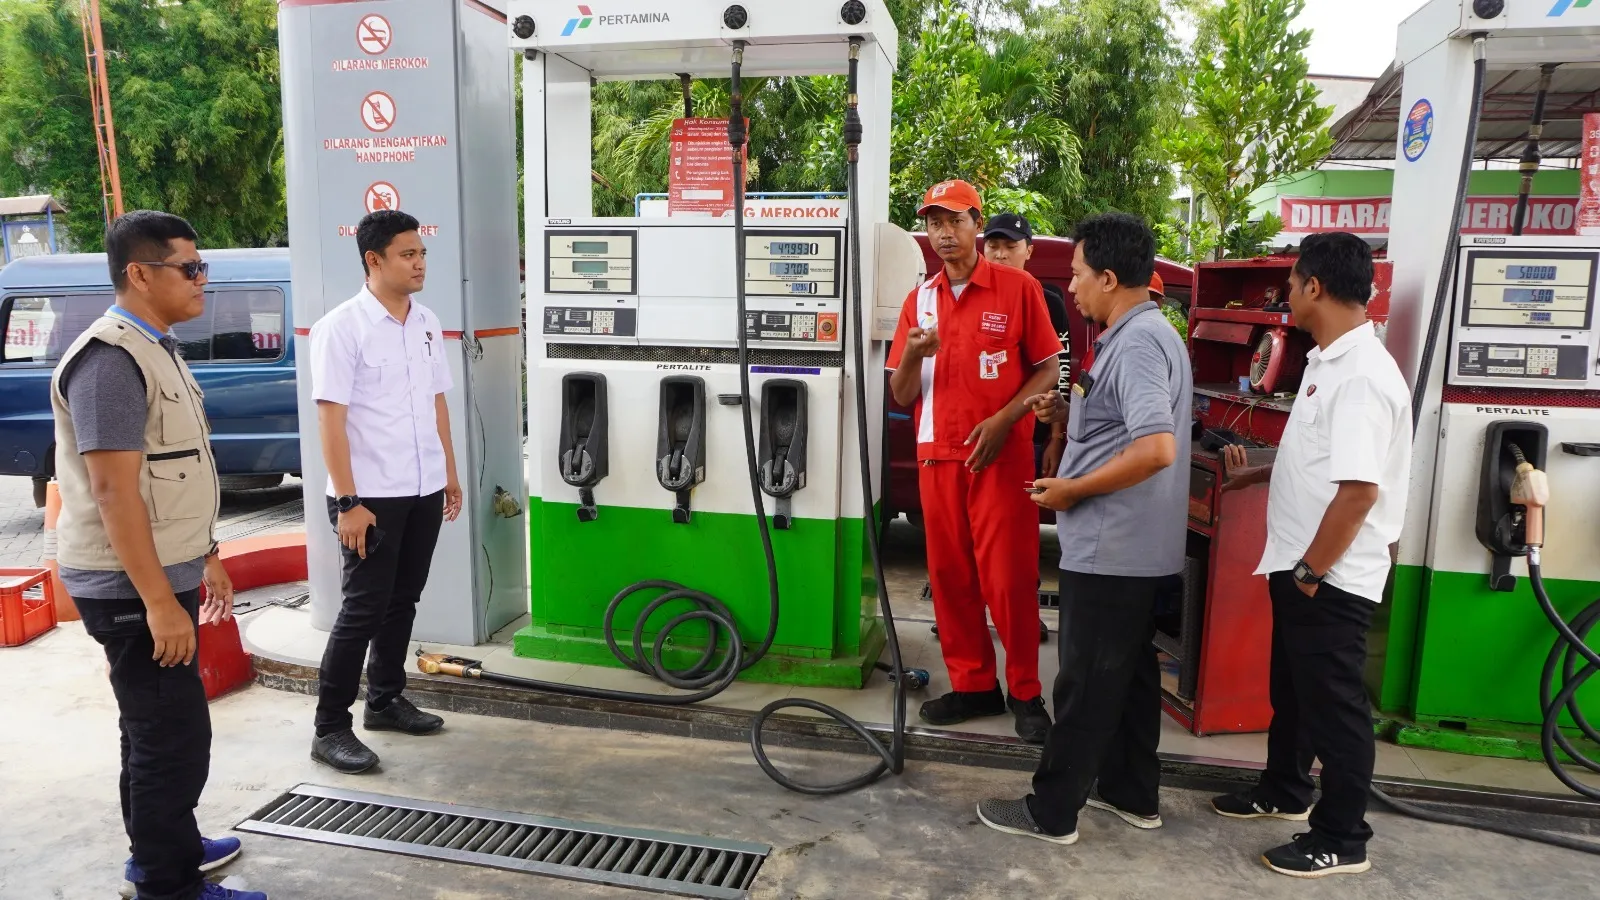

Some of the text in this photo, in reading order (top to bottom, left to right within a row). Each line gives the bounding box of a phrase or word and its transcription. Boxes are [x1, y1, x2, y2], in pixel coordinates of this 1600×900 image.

[599, 12, 670, 26] PERTAMINA
[332, 57, 428, 71] DILARANG MEROKOK
[324, 135, 447, 149] DILARANG MENGAKTIFKAN
[1291, 203, 1390, 228] DILARA
[338, 225, 438, 236] DILA RET
[1519, 266, 1554, 279] 50000
[656, 363, 712, 371] PERTALITE
[1476, 406, 1550, 416] PERTALITE
